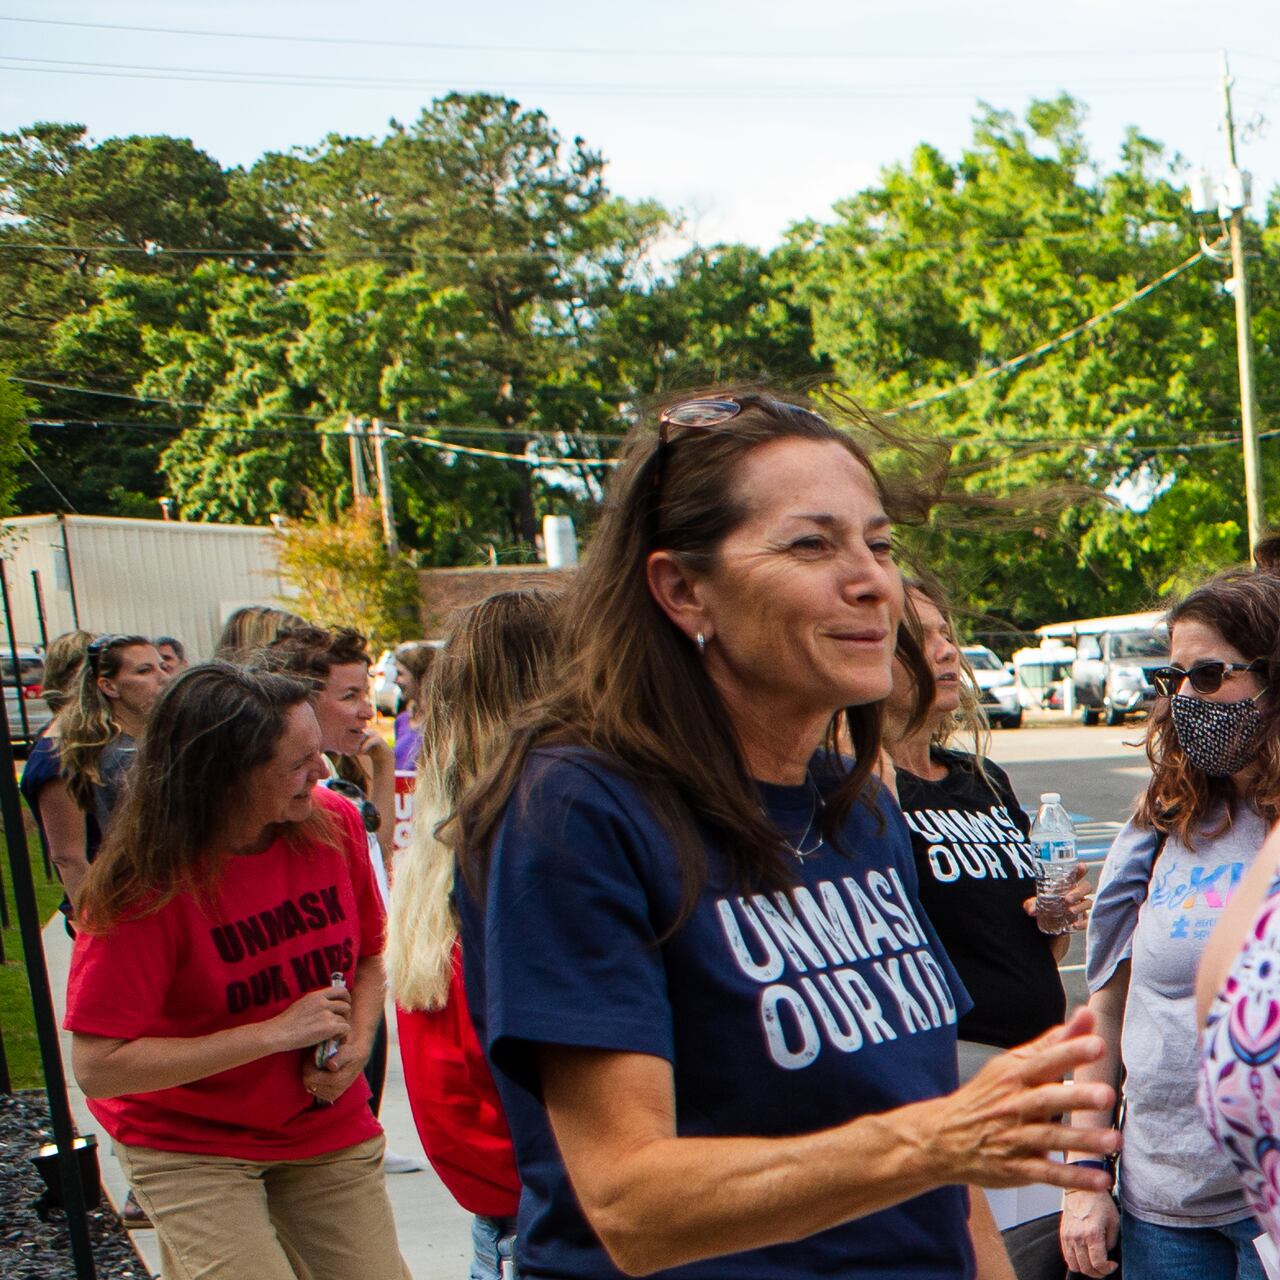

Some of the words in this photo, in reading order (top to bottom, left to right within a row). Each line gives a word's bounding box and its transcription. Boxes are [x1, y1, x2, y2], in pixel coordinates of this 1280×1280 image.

[902, 805, 1025, 844] UNMAS
[928, 844, 1008, 883] OUR
[1000, 843, 1036, 880] KI
[210, 885, 346, 963] UNMASK
[225, 964, 290, 1015] OUR
[760, 968, 898, 1071] OUR
[873, 950, 958, 1035] KID
